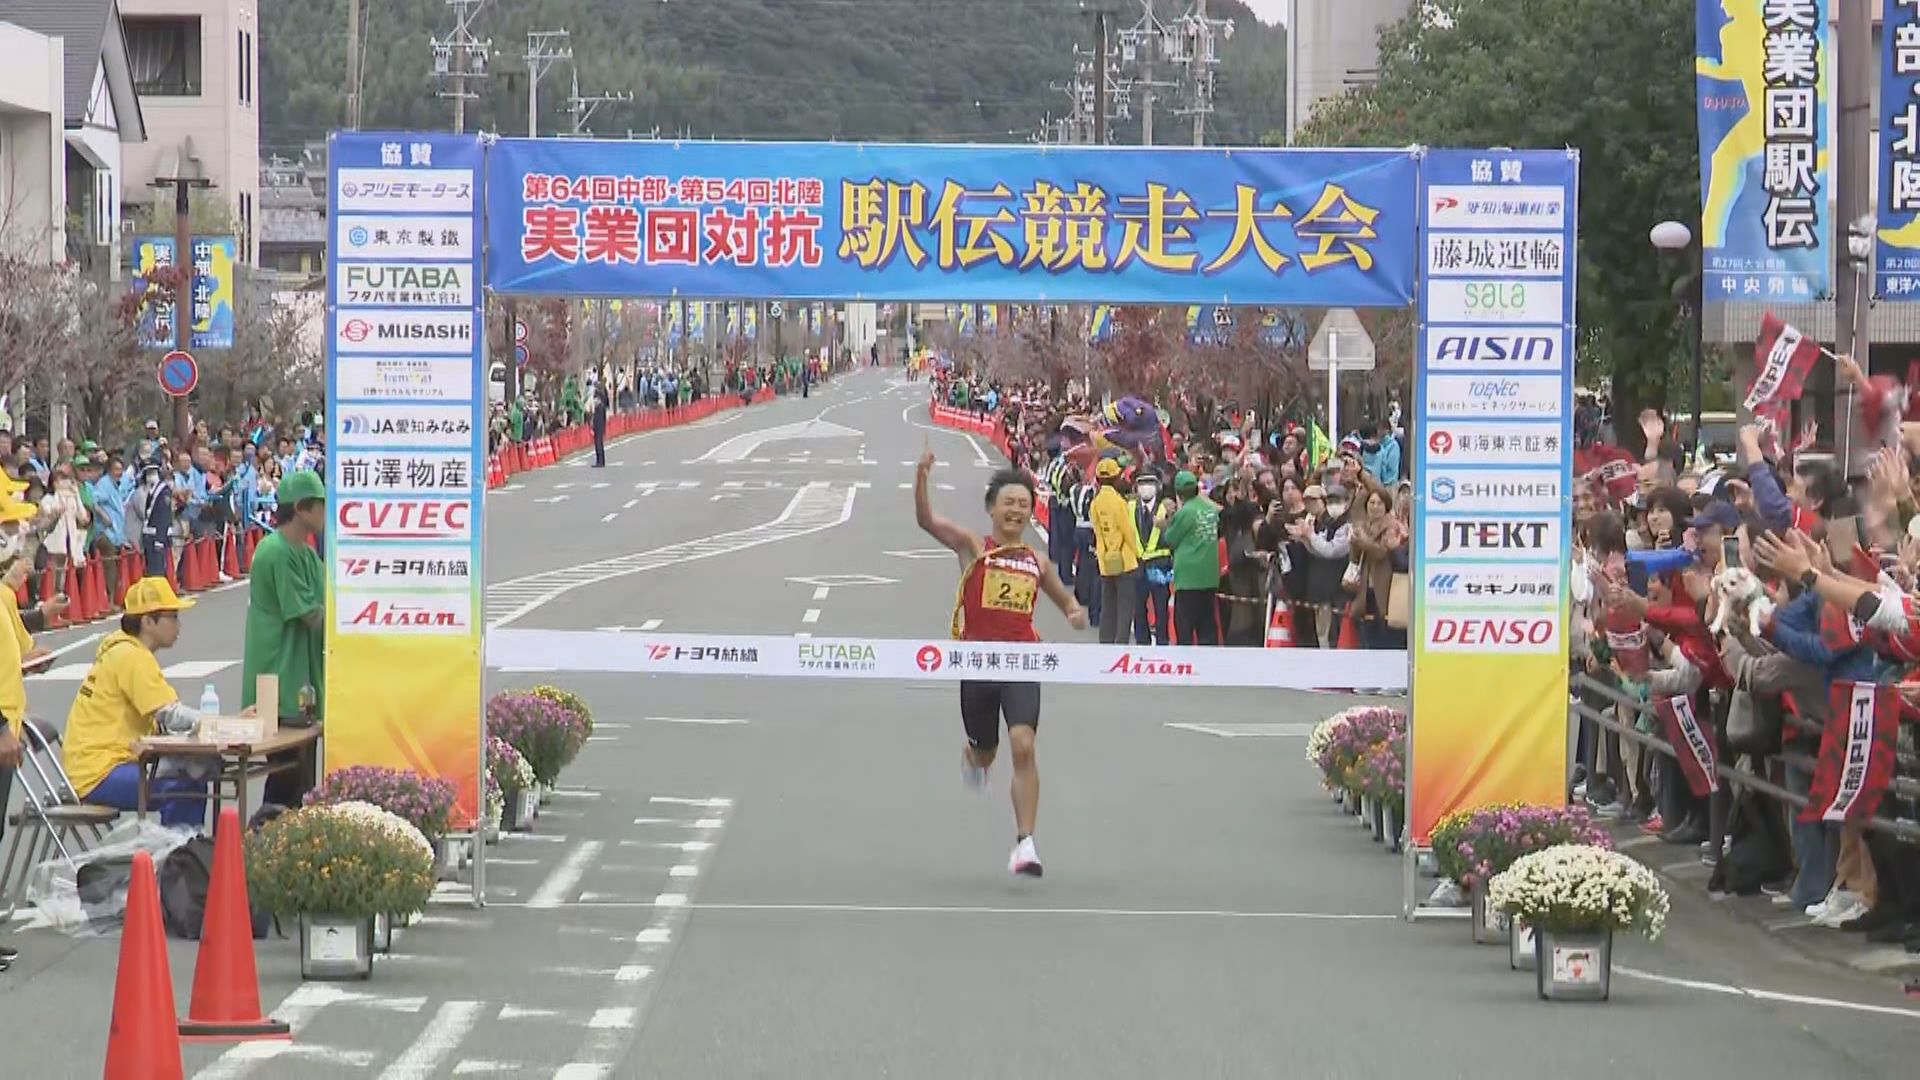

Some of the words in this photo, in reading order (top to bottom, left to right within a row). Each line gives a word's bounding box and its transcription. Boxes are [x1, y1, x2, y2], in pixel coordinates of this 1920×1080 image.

[381, 143, 432, 166] 協賛
[1471, 160, 1522, 182] 協賛
[359, 183, 470, 198] アツミモータース
[524, 175, 823, 205] 第64回中部・第54回北陸
[522, 206, 823, 265] 実業団対抗
[839, 179, 1380, 273] 駅伝競走大会
[1432, 239, 1560, 269] 藤城運輸
[348, 267, 460, 288] FUTABA
[1436, 337, 1553, 360] AISIN
[1468, 379, 1520, 399] TOENEC
[371, 418, 470, 434] JA愛知みなみ
[1458, 435, 1559, 452] 東海東京証券
[341, 458, 468, 488] 前澤物産
[1460, 483, 1556, 496] SHINMEI
[339, 501, 469, 528] CVTEC
[1438, 521, 1549, 553] JTEKT
[374, 560, 469, 576] トヨタ紡織
[353, 601, 458, 625] Aisan
[1432, 619, 1553, 644] DENSO
[675, 646, 758, 662] トヨタ紡織
[798, 644, 876, 660] FUTABA
[948, 651, 1060, 671] 東海東京証券
[1109, 653, 1193, 675] Aisan
